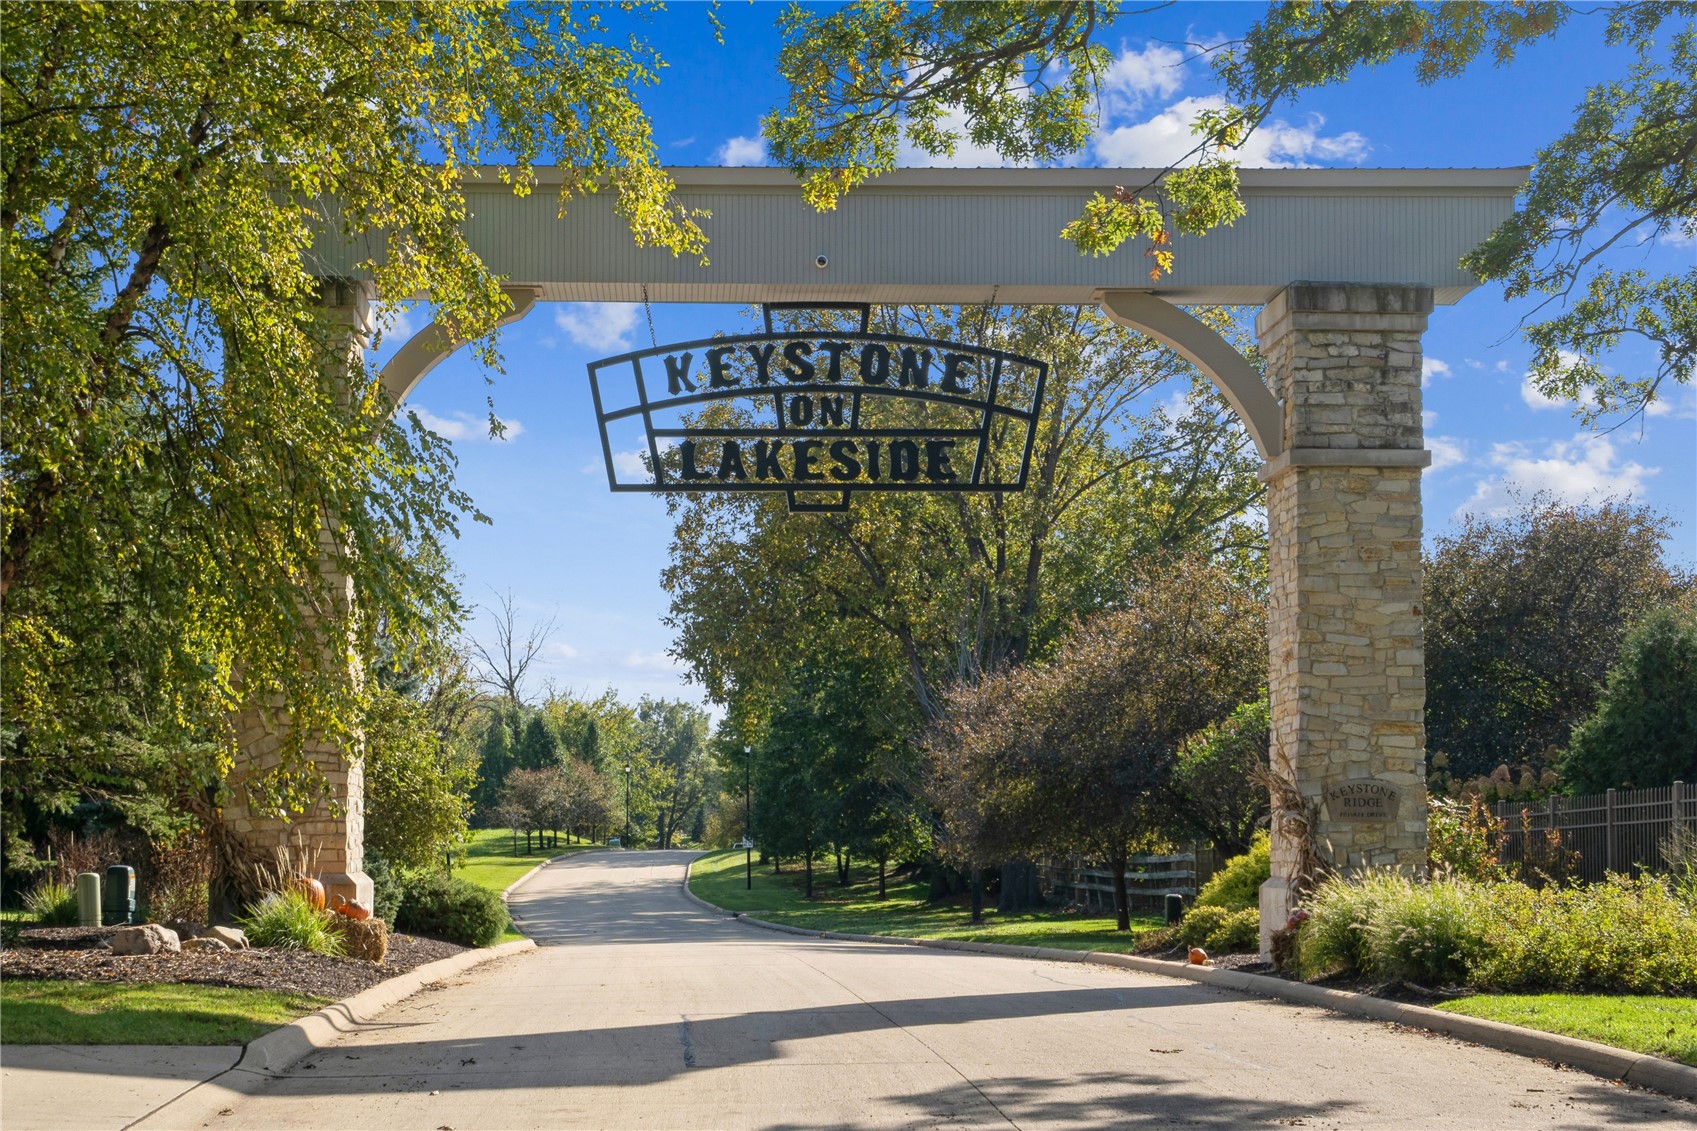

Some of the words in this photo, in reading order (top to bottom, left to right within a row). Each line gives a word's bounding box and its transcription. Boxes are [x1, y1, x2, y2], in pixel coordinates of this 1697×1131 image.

[663, 342, 976, 395] KEYSTONE
[791, 395, 844, 427] ON
[681, 440, 957, 482] LAKESIDE
[1329, 784, 1397, 801] KEYSTONE
[1344, 797, 1383, 807] RIDGE
